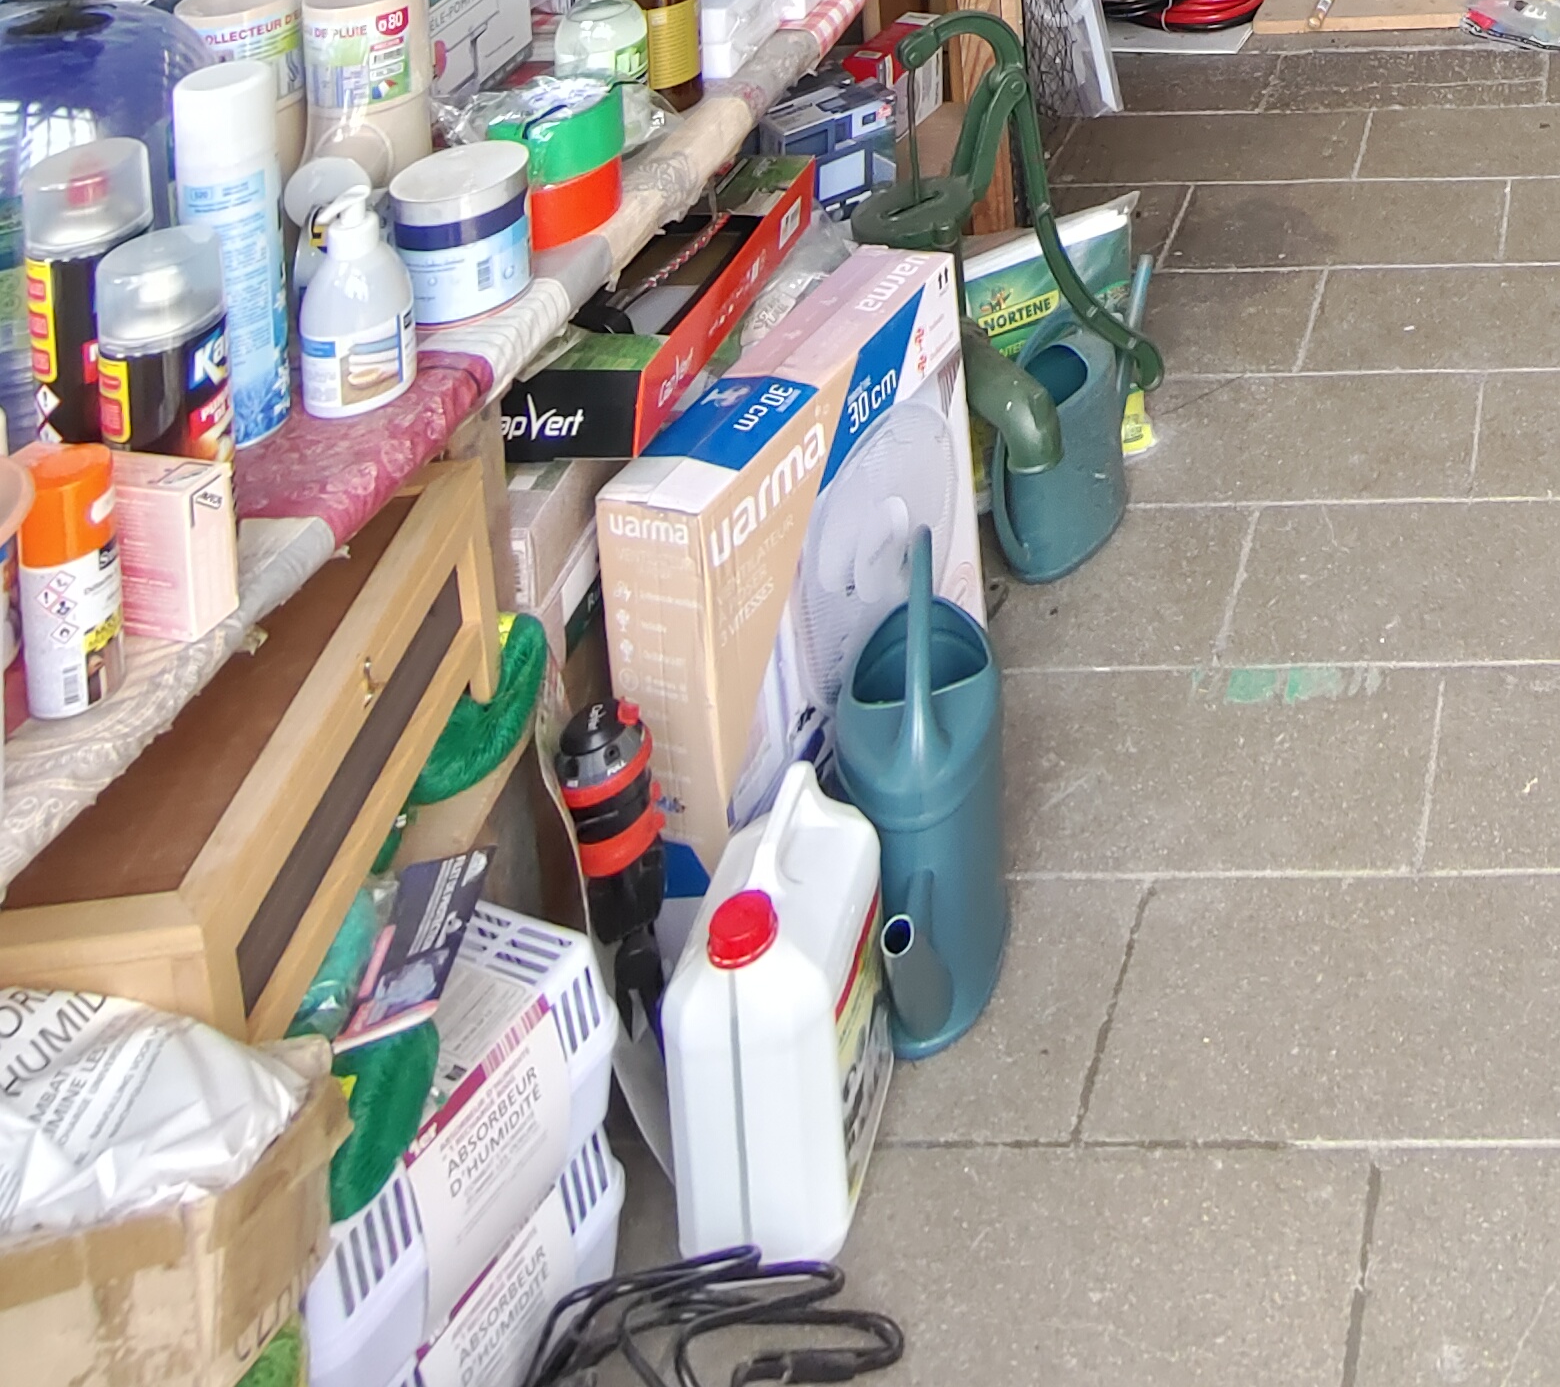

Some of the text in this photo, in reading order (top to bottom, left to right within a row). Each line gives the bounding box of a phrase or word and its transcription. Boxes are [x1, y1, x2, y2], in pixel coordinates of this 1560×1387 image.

[202, 9, 301, 45] OLLECTEUR D'E
[983, 297, 1053, 332] NORTENE
[500, 393, 584, 441] apVert
[847, 397, 870, 433] 30
[27, 1069, 71, 1122] MBAT
[448, 1066, 539, 1179] ABSORBEUR
[449, 1082, 543, 1199] D'HUMIDITÉ
[460, 1244, 547, 1368] ABSORBEUR
